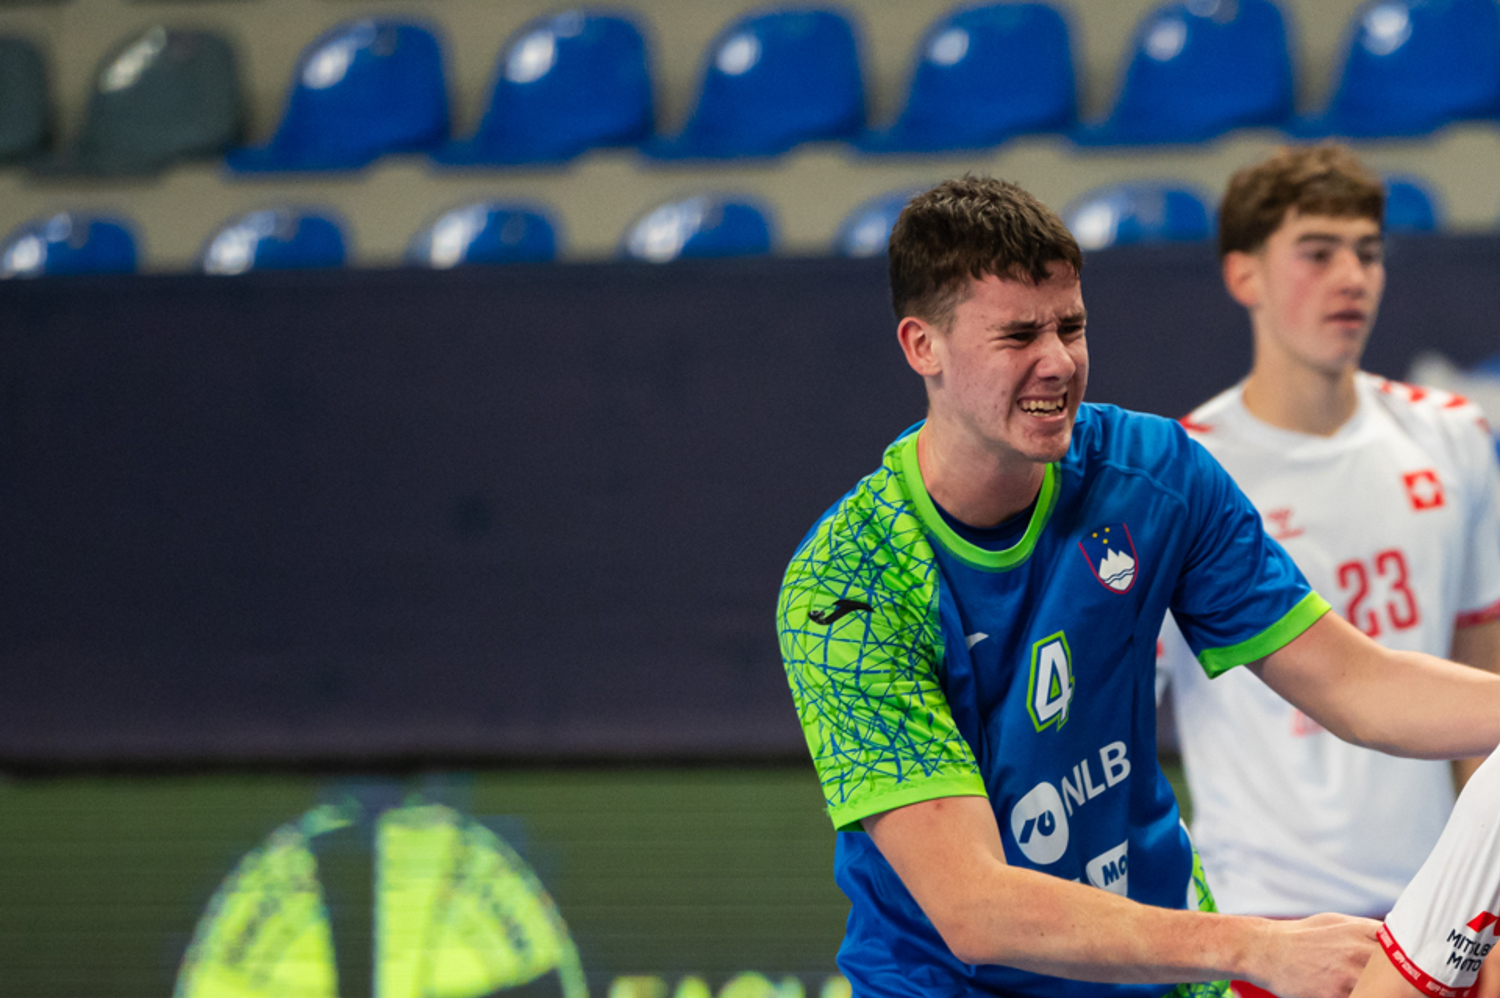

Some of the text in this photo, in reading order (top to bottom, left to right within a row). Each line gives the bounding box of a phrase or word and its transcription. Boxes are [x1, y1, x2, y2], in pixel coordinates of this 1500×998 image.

[1338, 549, 1422, 640] 23
[1029, 634, 1074, 728] 4
[1061, 740, 1131, 817] NLB
[1101, 854, 1128, 887] MO
